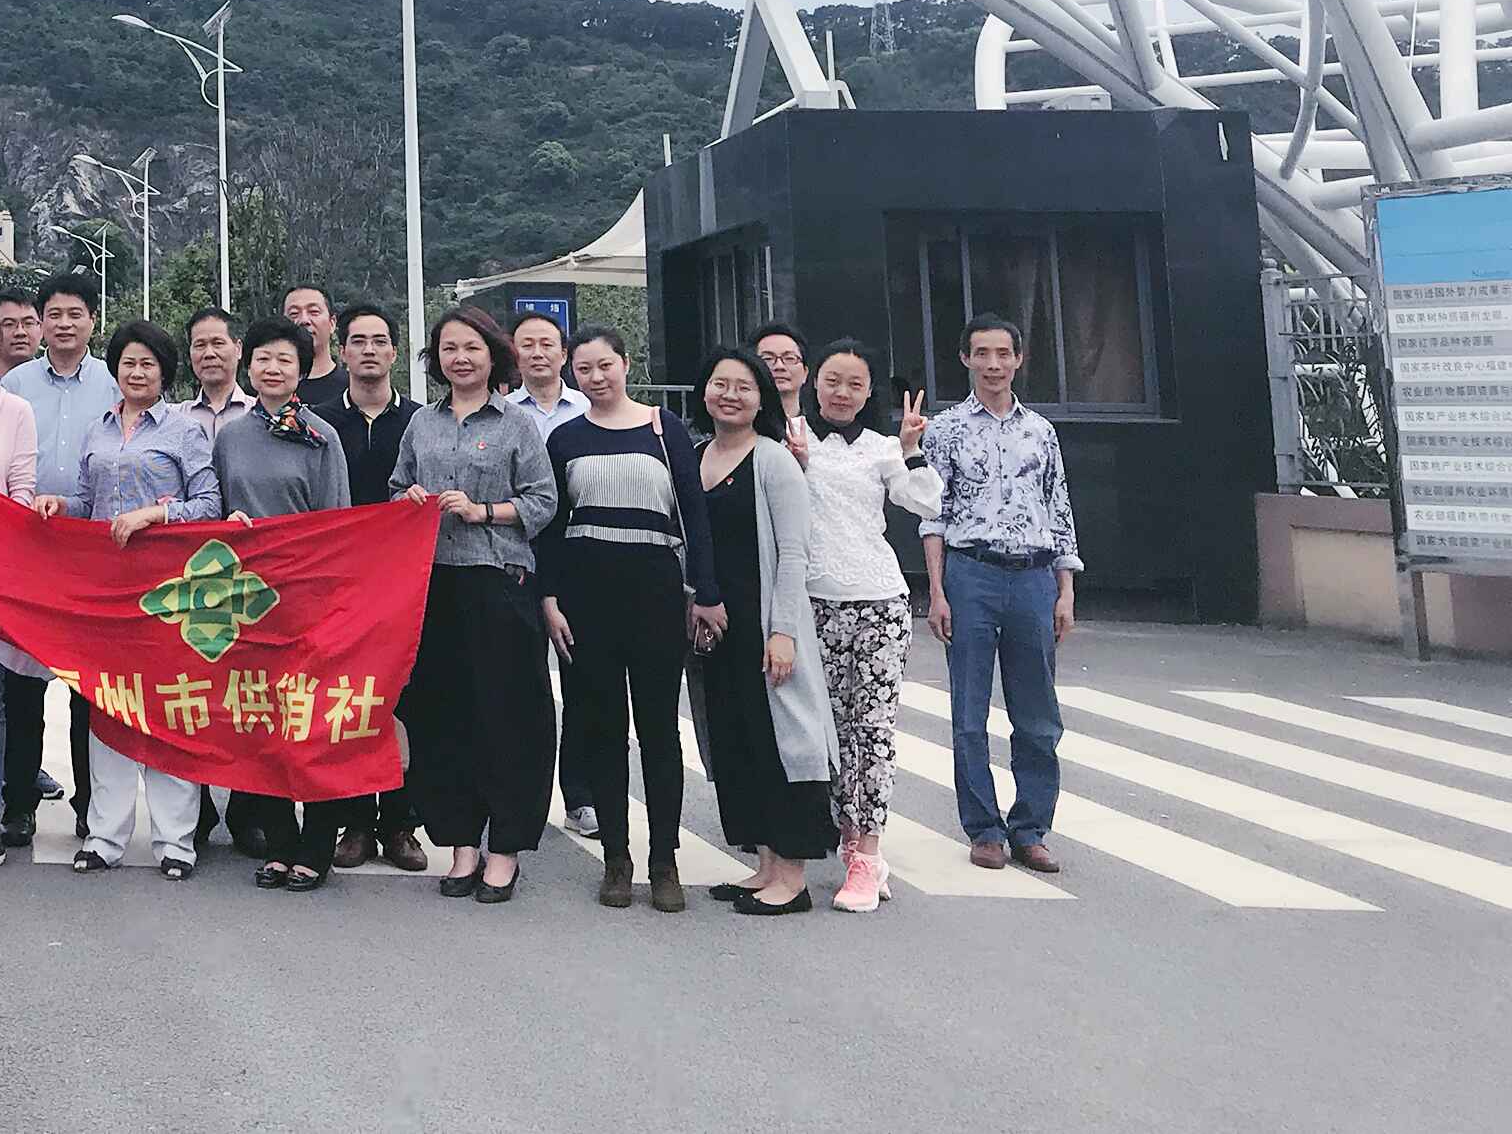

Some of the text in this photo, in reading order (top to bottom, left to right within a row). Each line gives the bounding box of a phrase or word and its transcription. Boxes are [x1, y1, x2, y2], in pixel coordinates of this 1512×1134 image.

[49, 666, 385, 744] 州市供销社
